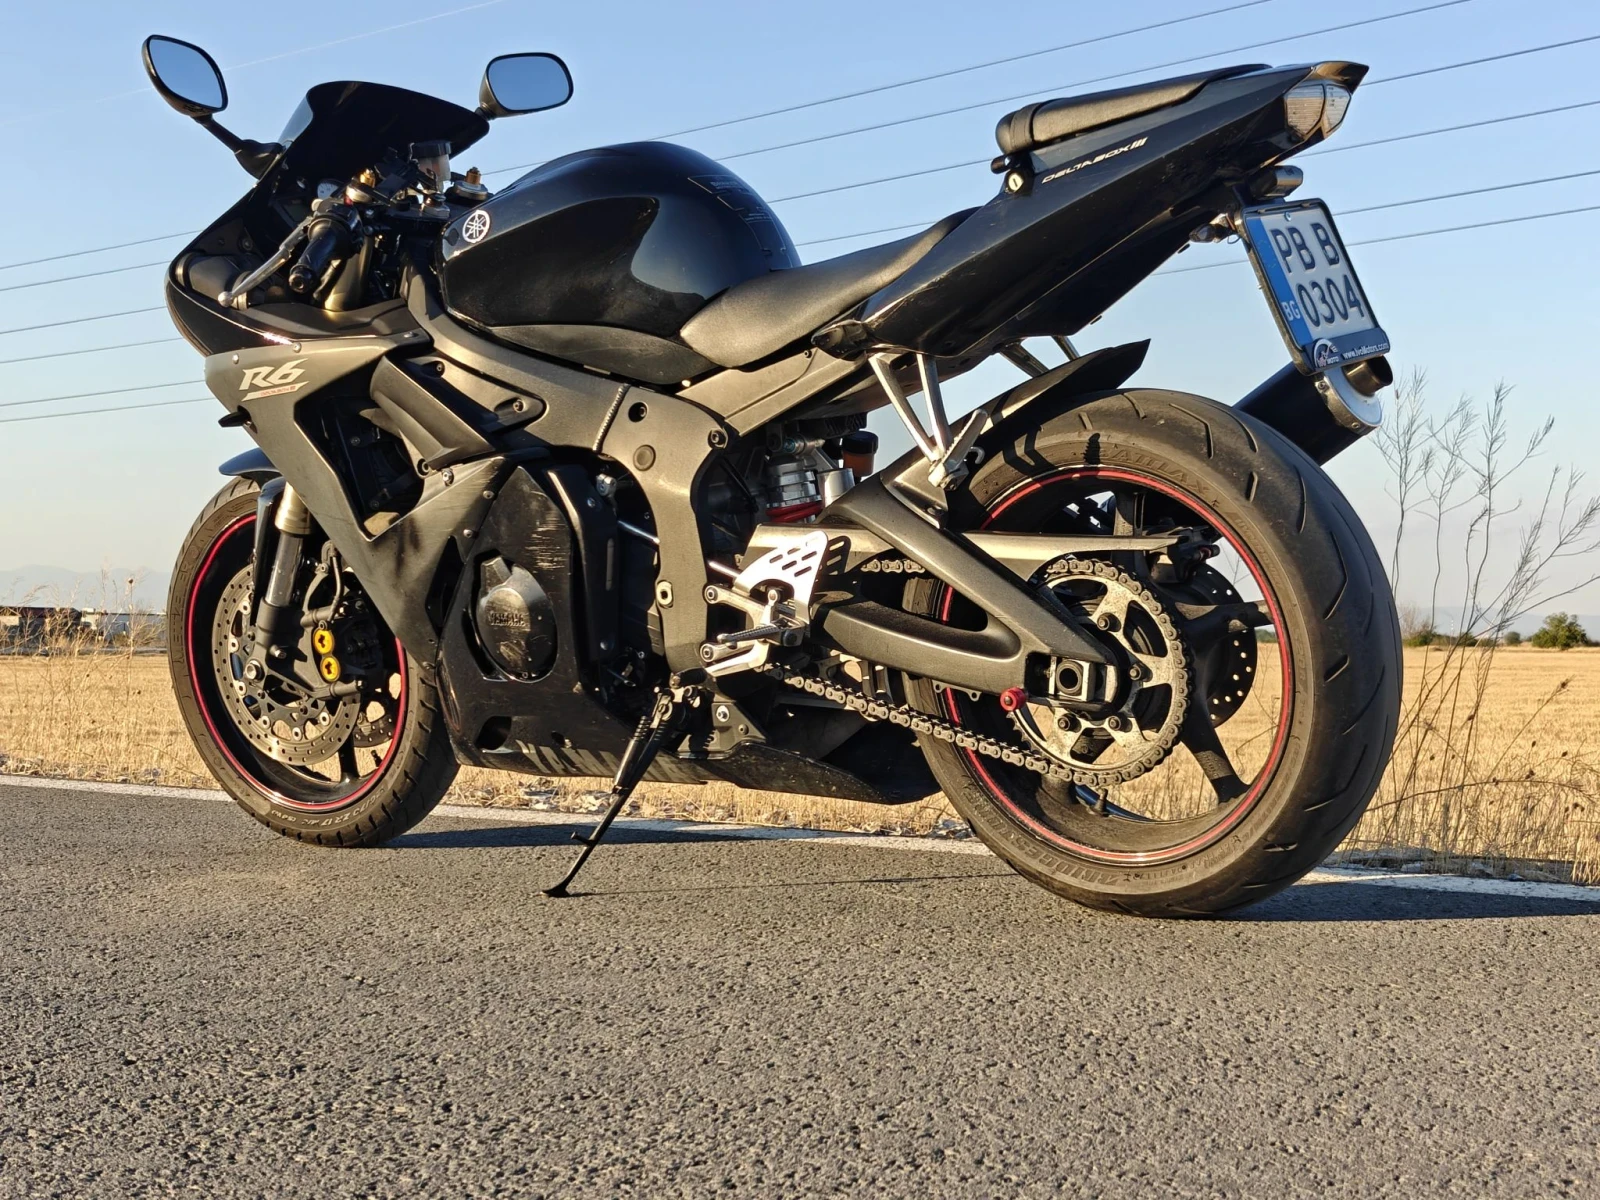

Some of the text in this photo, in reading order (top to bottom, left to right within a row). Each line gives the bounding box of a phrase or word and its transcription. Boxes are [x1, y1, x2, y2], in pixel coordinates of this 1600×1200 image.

[1269, 221, 1340, 273] PB B
[1281, 301, 1301, 321] BG
[1295, 274, 1365, 328] 0304
[238, 357, 309, 391] R6
